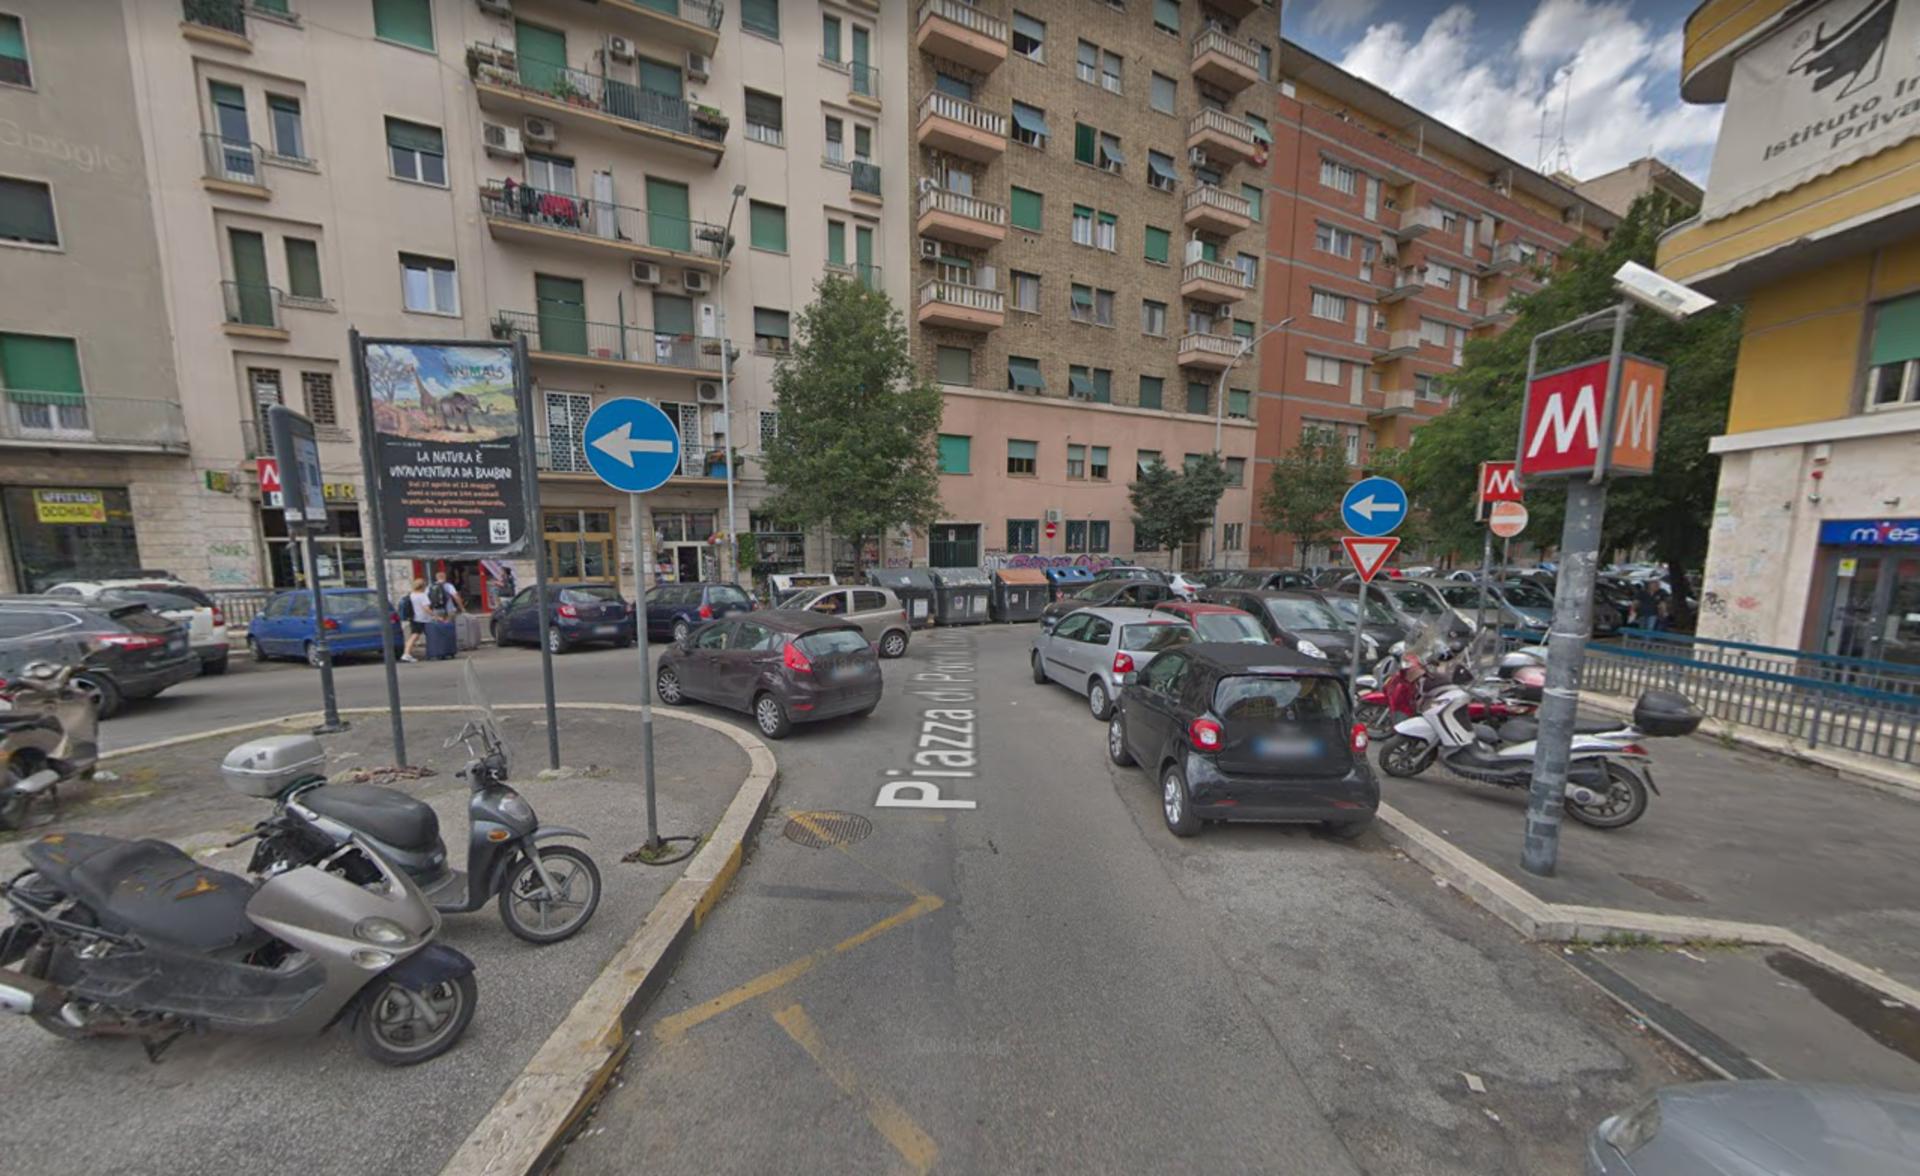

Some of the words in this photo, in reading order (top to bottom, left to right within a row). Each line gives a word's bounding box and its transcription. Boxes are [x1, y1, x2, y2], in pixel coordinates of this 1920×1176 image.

[1763, 95, 1882, 161] Istituto
[1526, 384, 1600, 458] M
[1615, 379, 1654, 451] M
[416, 451, 430, 463] LA
[432, 450, 473, 463] NATURA
[461, 466, 474, 478] DA
[1486, 469, 1519, 494] M
